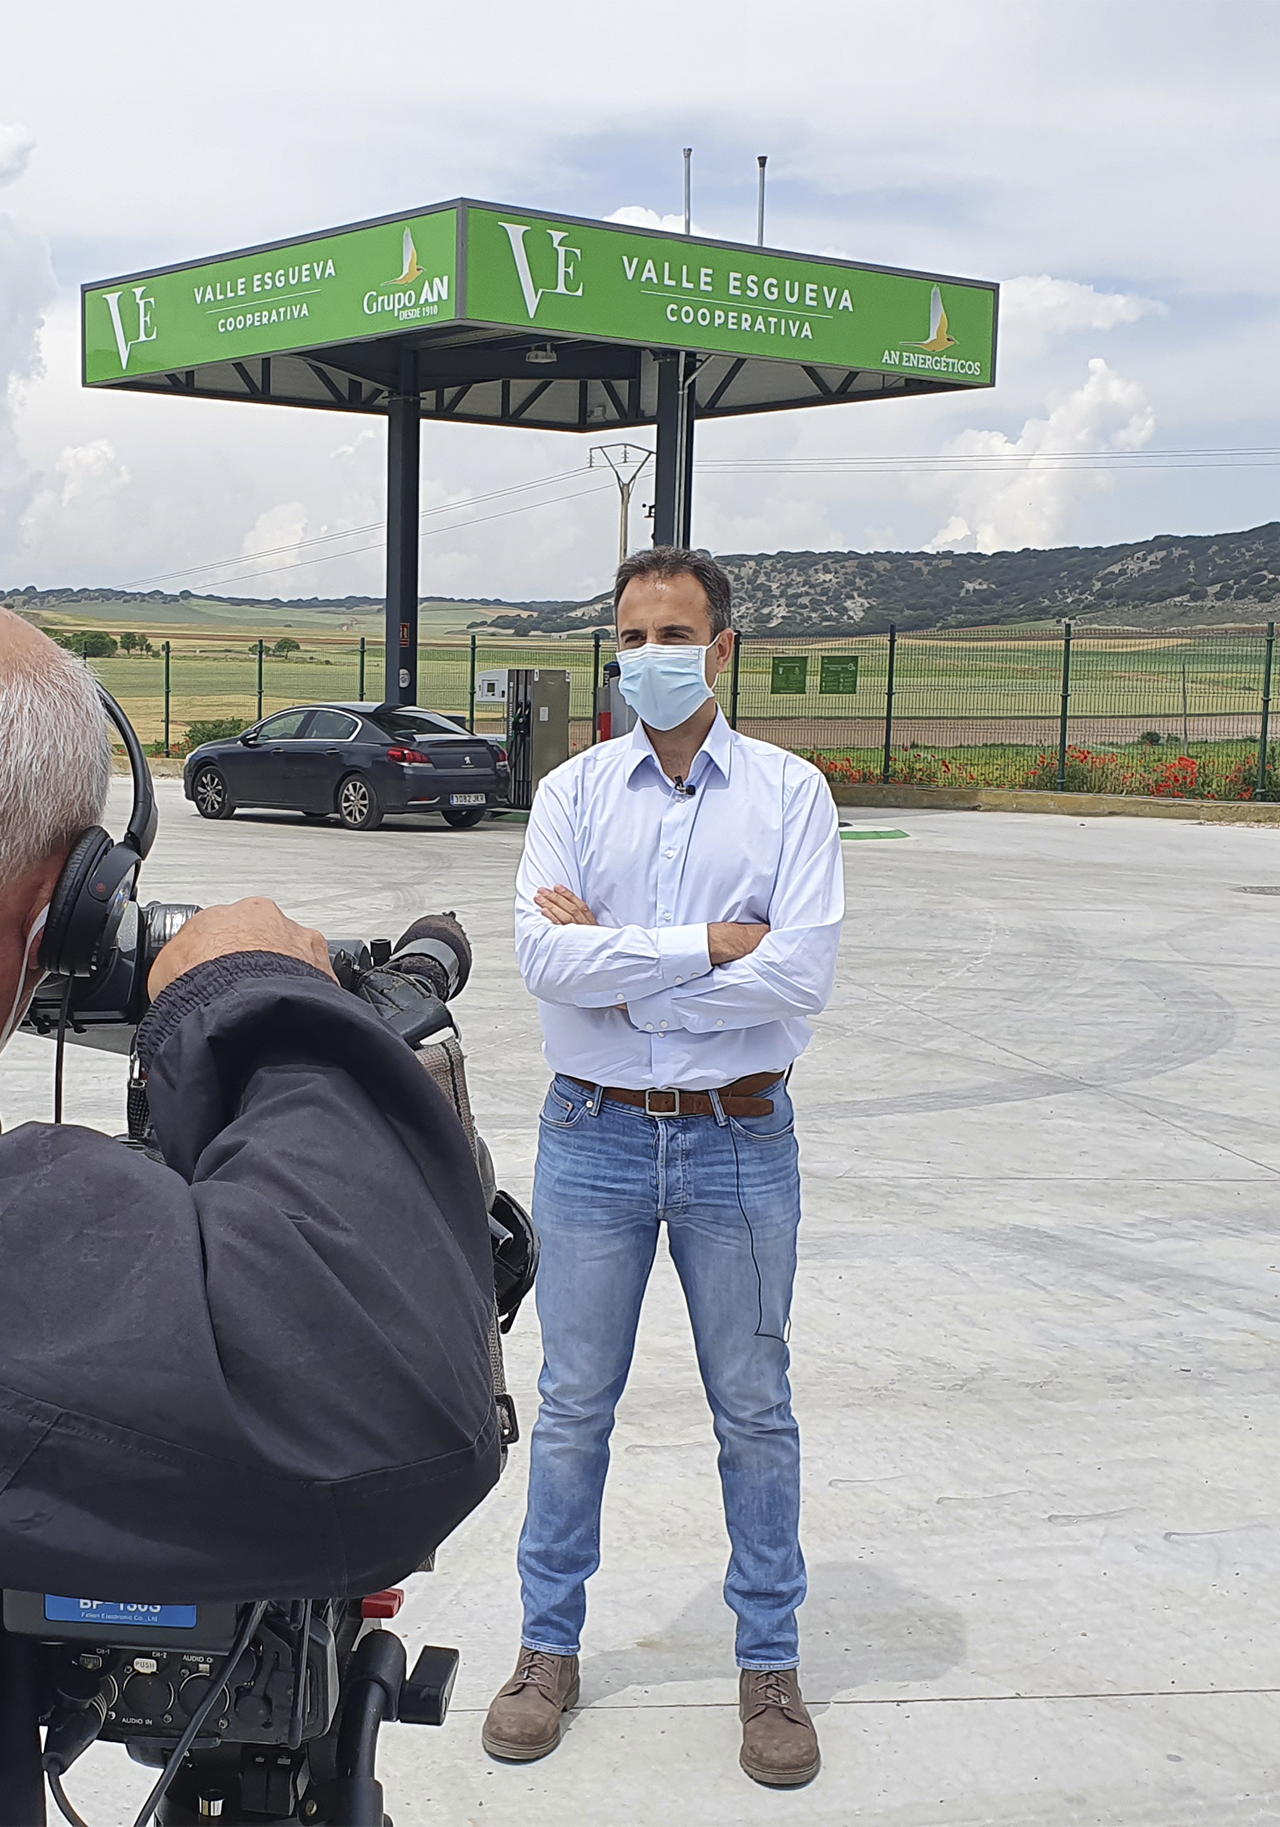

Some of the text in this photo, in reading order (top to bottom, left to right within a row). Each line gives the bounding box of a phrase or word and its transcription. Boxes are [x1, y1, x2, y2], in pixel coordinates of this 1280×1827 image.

[194, 259, 336, 304] VALLE ESGUEVA
[498, 222, 583, 319] VE
[622, 256, 854, 312] VALLE ESGUEVA
[363, 275, 449, 317] Grupo AN
[102, 286, 157, 370] VE
[218, 303, 309, 332] COOPERATIVA
[399, 305, 438, 321] DESDE 1910
[666, 304, 813, 339] COOPERATIVA
[881, 350, 981, 376] AN ENERGÉTICOS
[135, 1661, 155, 1669] PUSH
[183, 1655, 205, 1663] AUDIO
[121, 1717, 144, 1725] AUDIO
